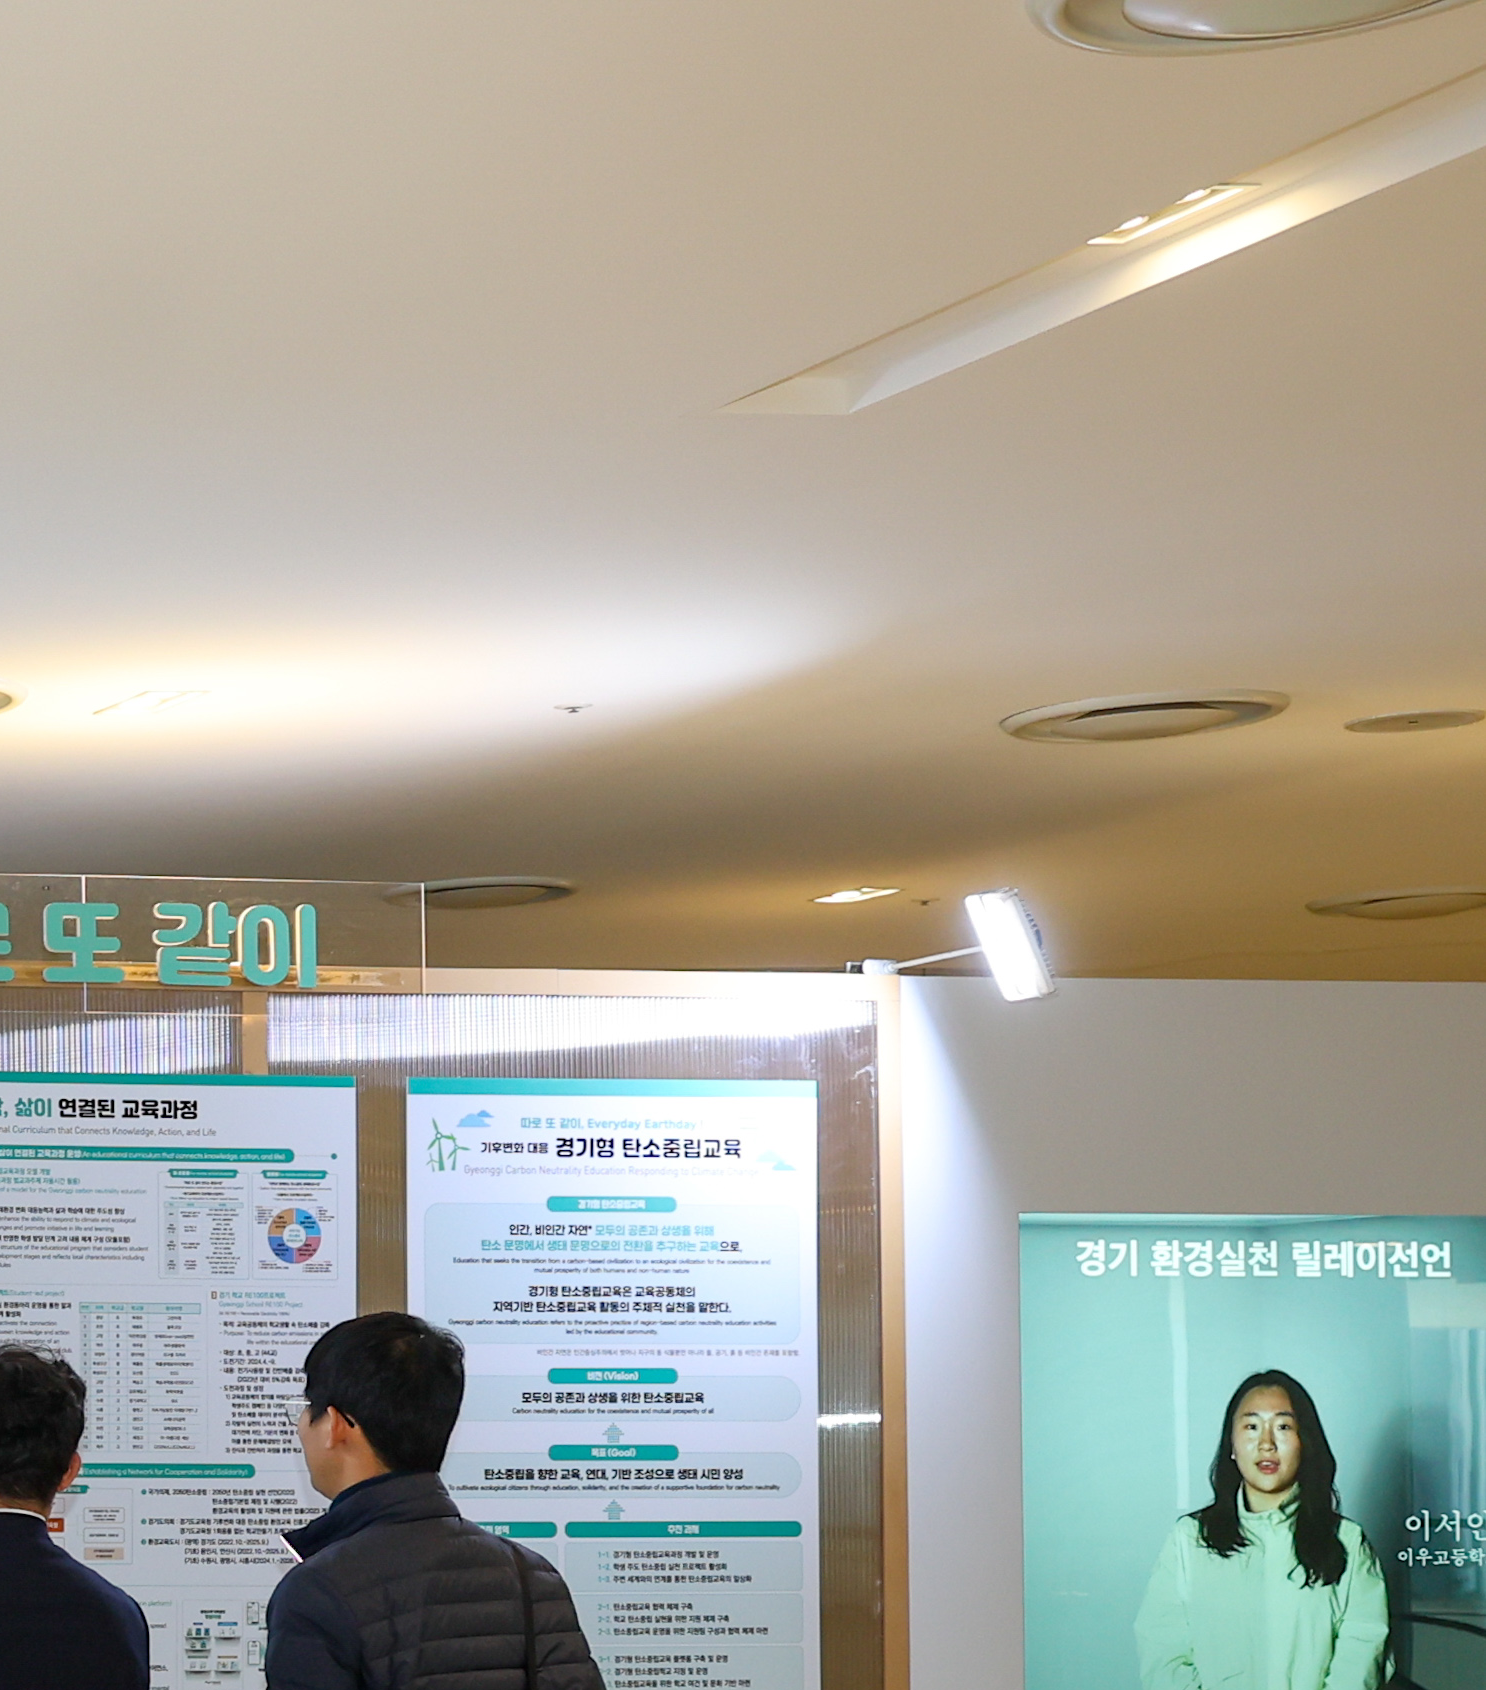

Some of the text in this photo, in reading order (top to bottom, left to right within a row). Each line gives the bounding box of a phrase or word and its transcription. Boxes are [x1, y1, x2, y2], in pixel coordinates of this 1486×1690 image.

[43, 902, 125, 984] 또
[152, 900, 317, 989] 같이
[14, 1097, 52, 1118] 삶이
[58, 1098, 115, 1119] 연결된
[121, 1099, 199, 1120] 교육과정
[588, 1118, 696, 1131] Everyday Earthday
[12, 1125, 56, 1134] Curriculum
[57, 1126, 72, 1135] that
[74, 1126, 110, 1135] Connects
[112, 1126, 156, 1137] Knowledge,
[158, 1127, 184, 1138] Action,
[186, 1127, 201, 1136] and
[202, 1128, 217, 1137] Life
[481, 1137, 742, 1159] 기후변화 경기형 탄소중립교육
[464, 1165, 626, 1177] Gyeonggi Carbon Neutrality Education
[509, 1224, 625, 1237] 인간, 비인간 모두의
[481, 1240, 697, 1253] 탄소 문명에서 생태 추구하는
[1076, 1239, 1453, 1279] 경기 환경실천 릴레이선언
[528, 1286, 695, 1298] 경기형 탄소중립교육은 교육공동체의
[493, 1301, 732, 1313] 지역기반 탄소중립교육 활동의 주체적 실천을 말한다.
[604, 1371, 639, 1381] (Vision)
[522, 1392, 705, 1404] 모두의 공존과 상생을 위한 탄소중립교육
[484, 1469, 744, 1481] 탄소중립을 향한 교육, 연대, 기반 조성으로 생태 시민 양성
